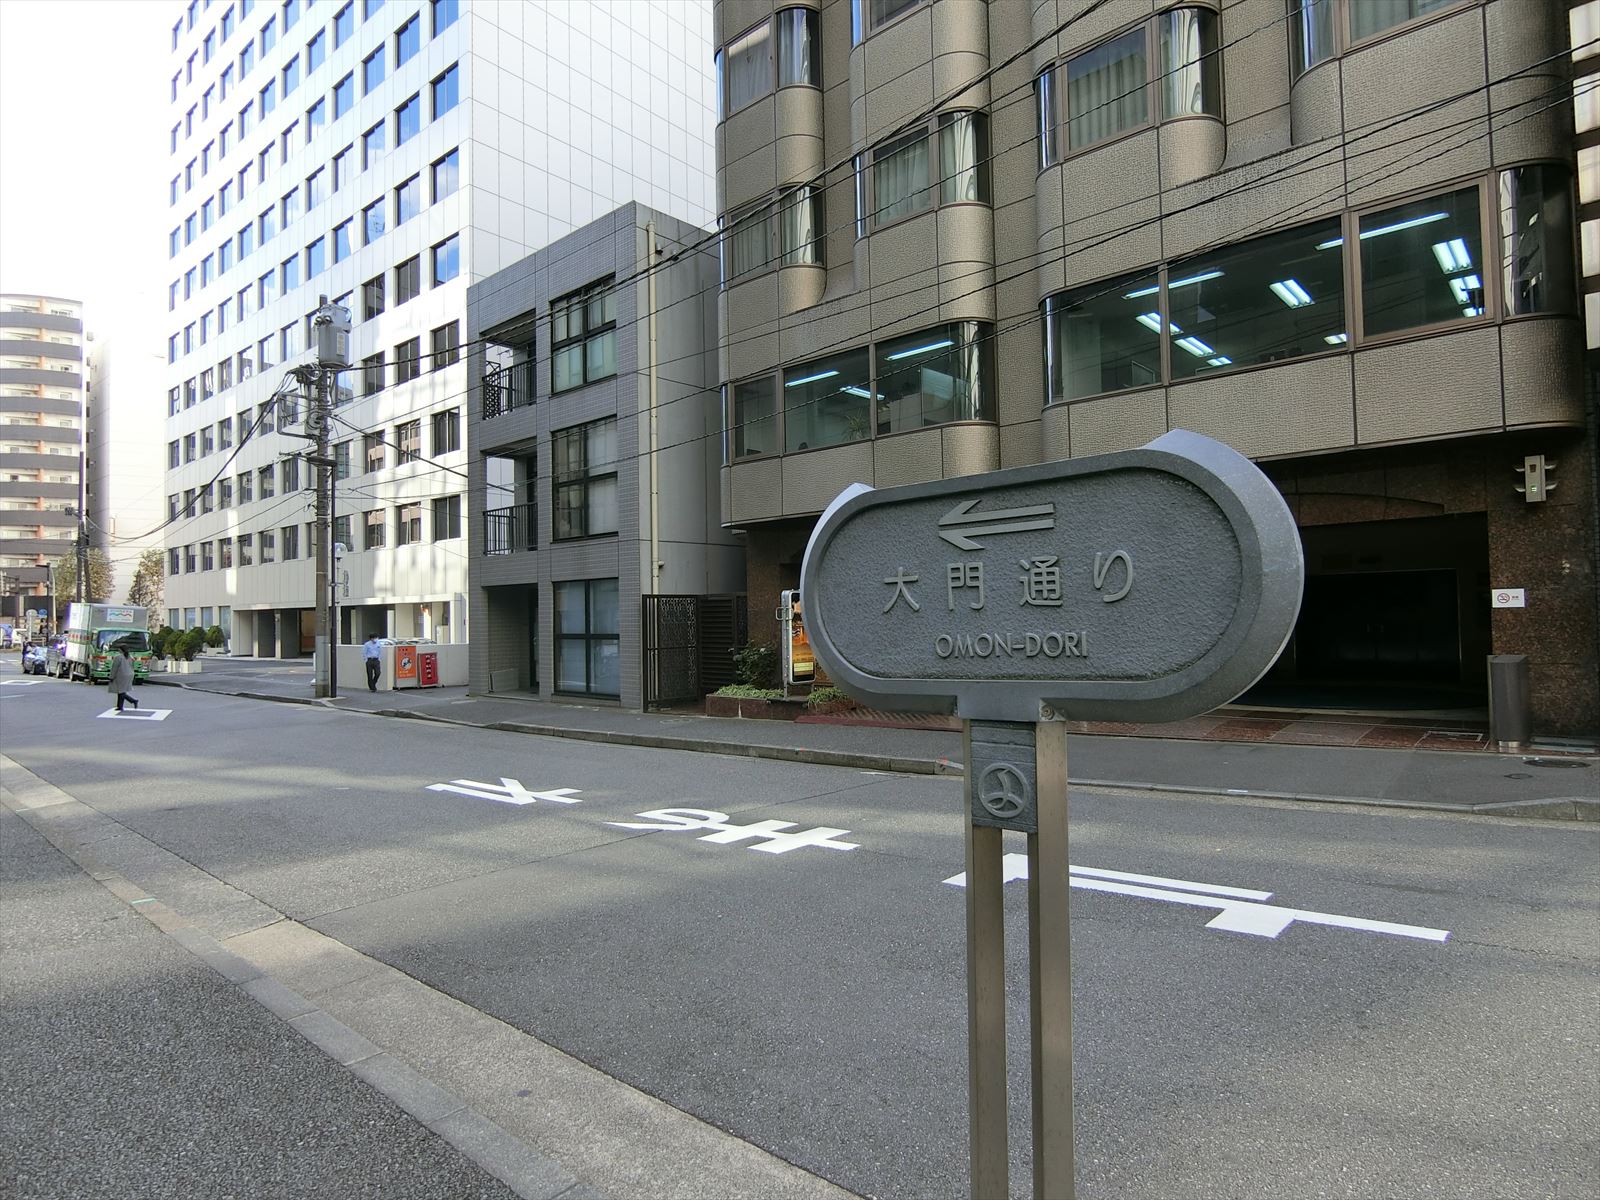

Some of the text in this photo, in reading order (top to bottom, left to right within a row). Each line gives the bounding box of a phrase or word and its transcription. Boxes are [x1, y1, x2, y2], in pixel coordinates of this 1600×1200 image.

[883, 550, 1133, 613] 大門通り
[936, 632, 1088, 658] OMON-DORI
